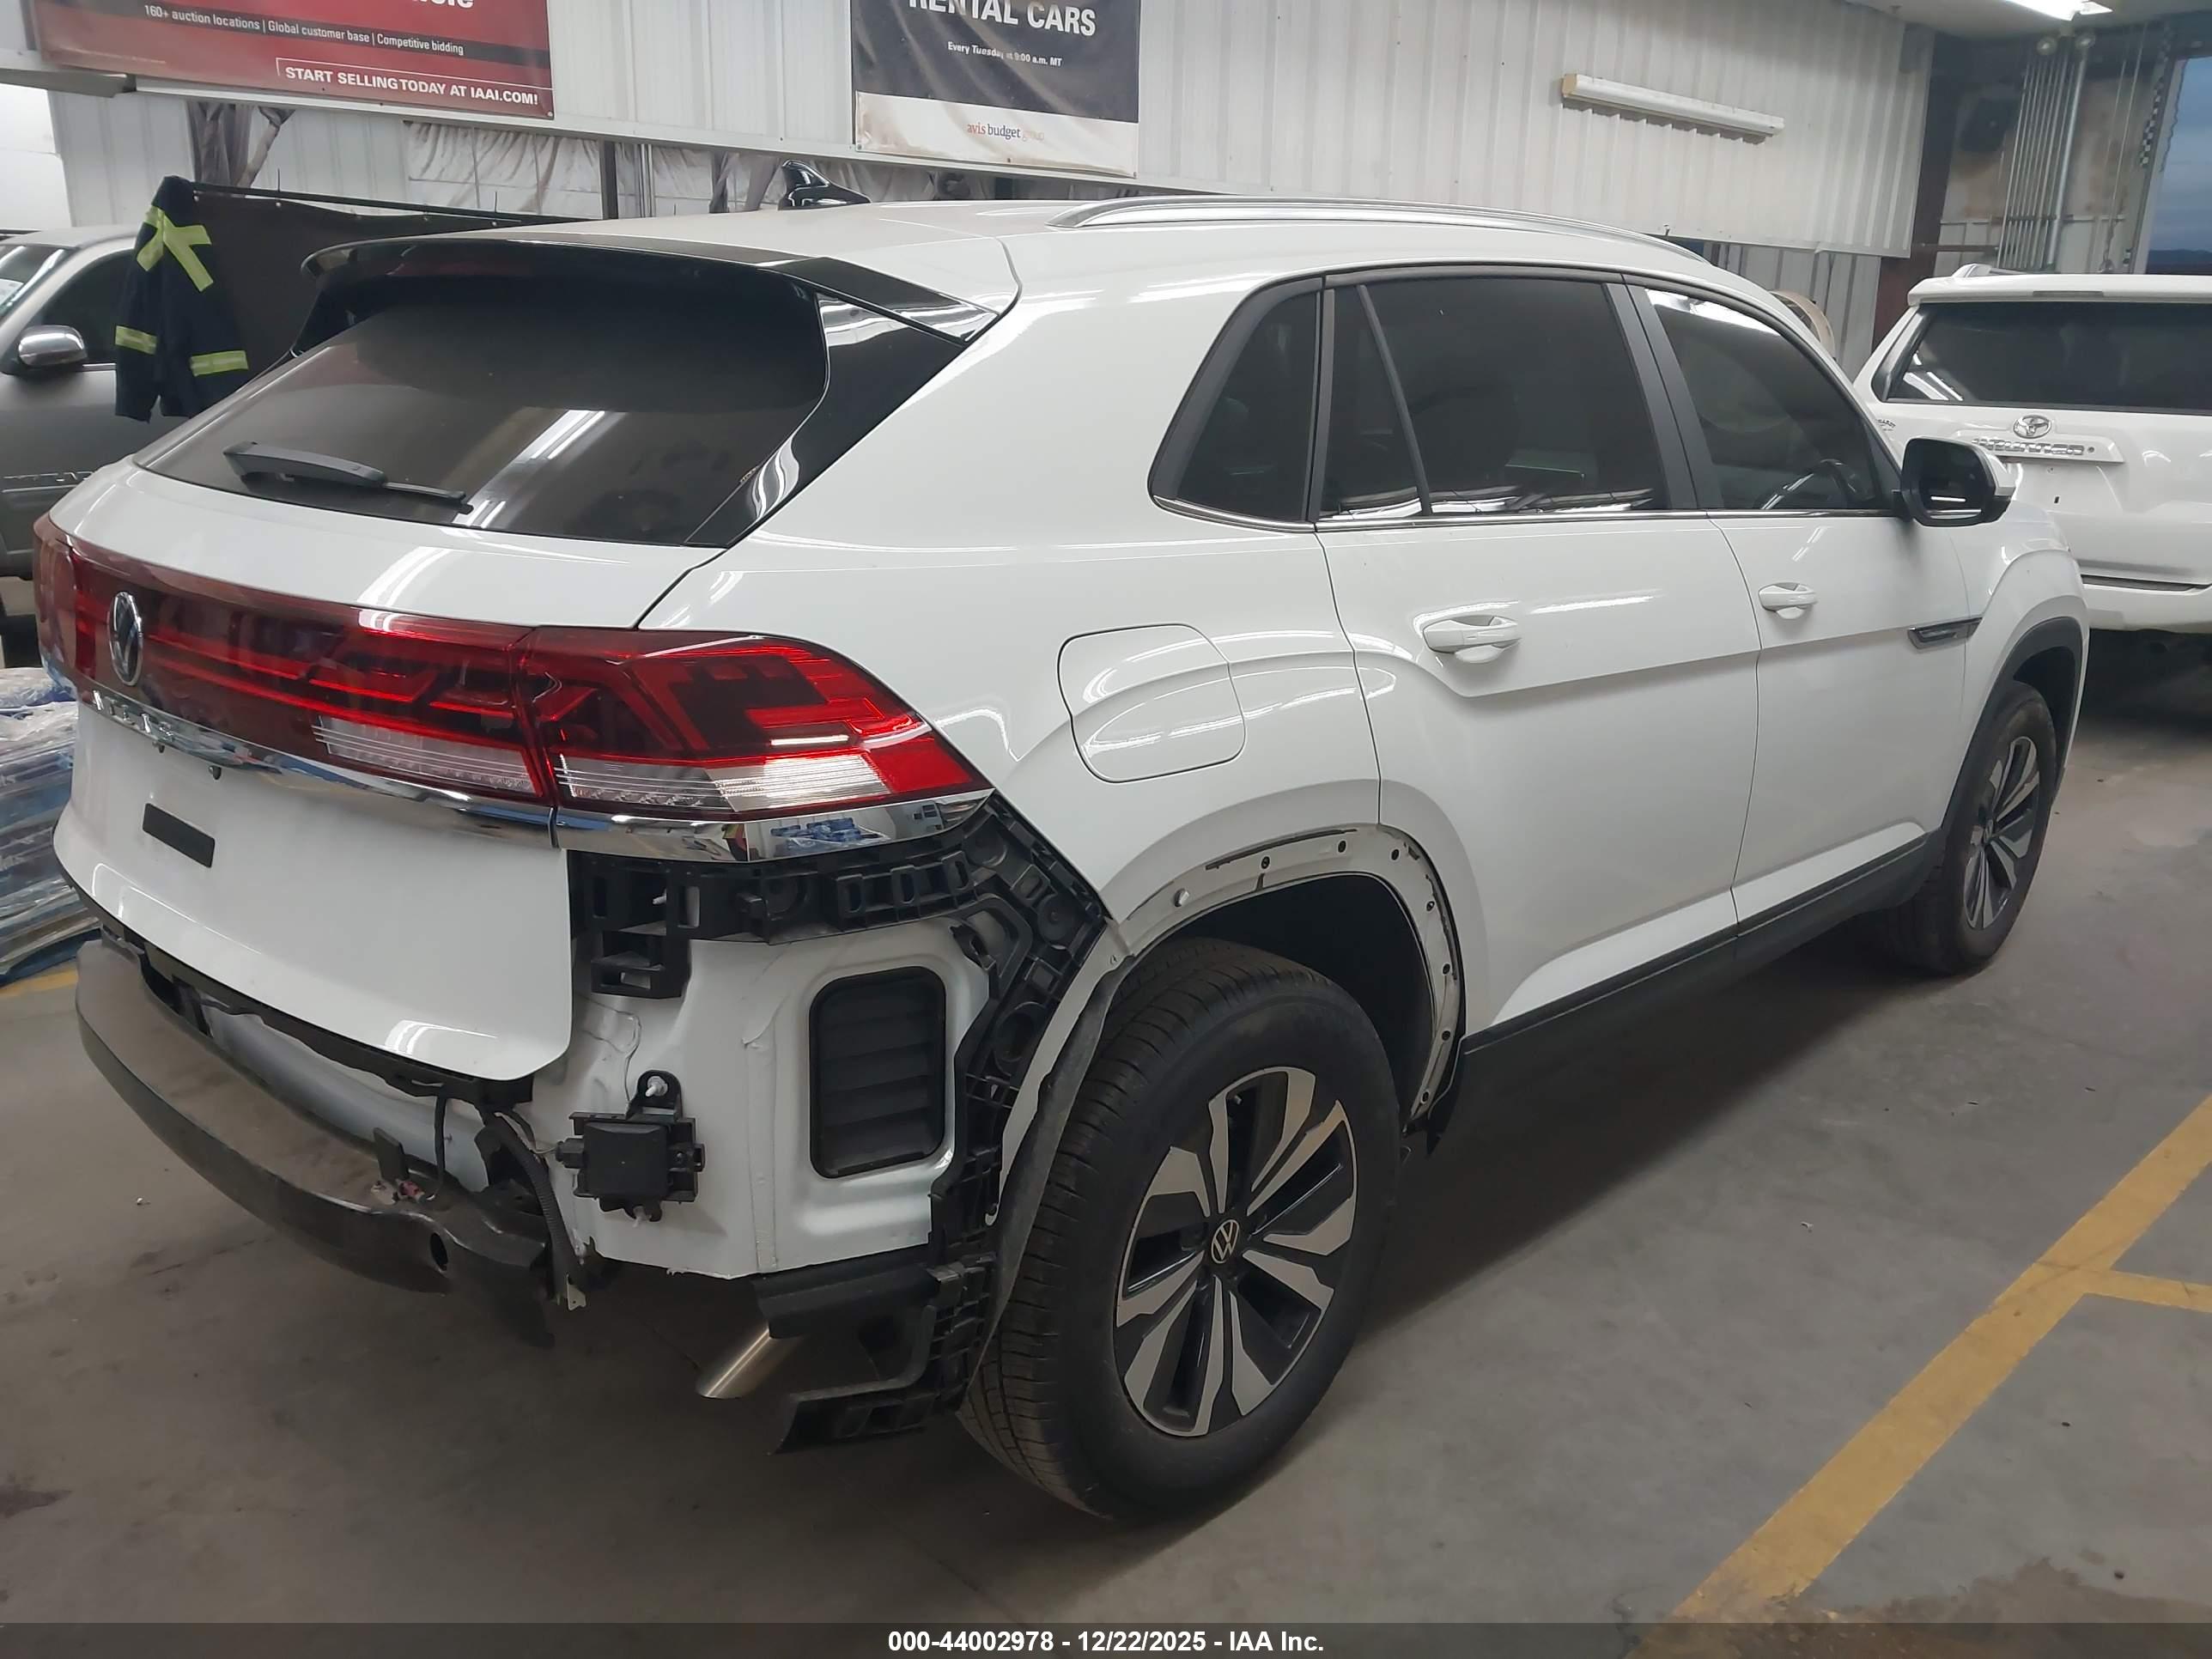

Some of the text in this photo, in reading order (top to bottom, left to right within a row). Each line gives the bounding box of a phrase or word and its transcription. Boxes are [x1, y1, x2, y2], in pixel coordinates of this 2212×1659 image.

[144, 5, 169, 18] 160+
[172, 10, 210, 24] auction
[213, 15, 259, 29] locations
[269, 21, 299, 34] Global
[301, 27, 344, 40] customer
[347, 30, 369, 42] base
[377, 33, 429, 50] Competitive
[432, 40, 464, 56] bidding
[909, 0, 1096, 36] NTAL CARS
[947, 41, 970, 54] Every
[1032, 56, 1048, 64] a.m.
[1049, 57, 1062, 66] MT
[285, 66, 538, 105] START SELLING TODAY AT IAAI.COM!
[967, 122, 987, 135] avis
[987, 124, 1021, 140] budget
